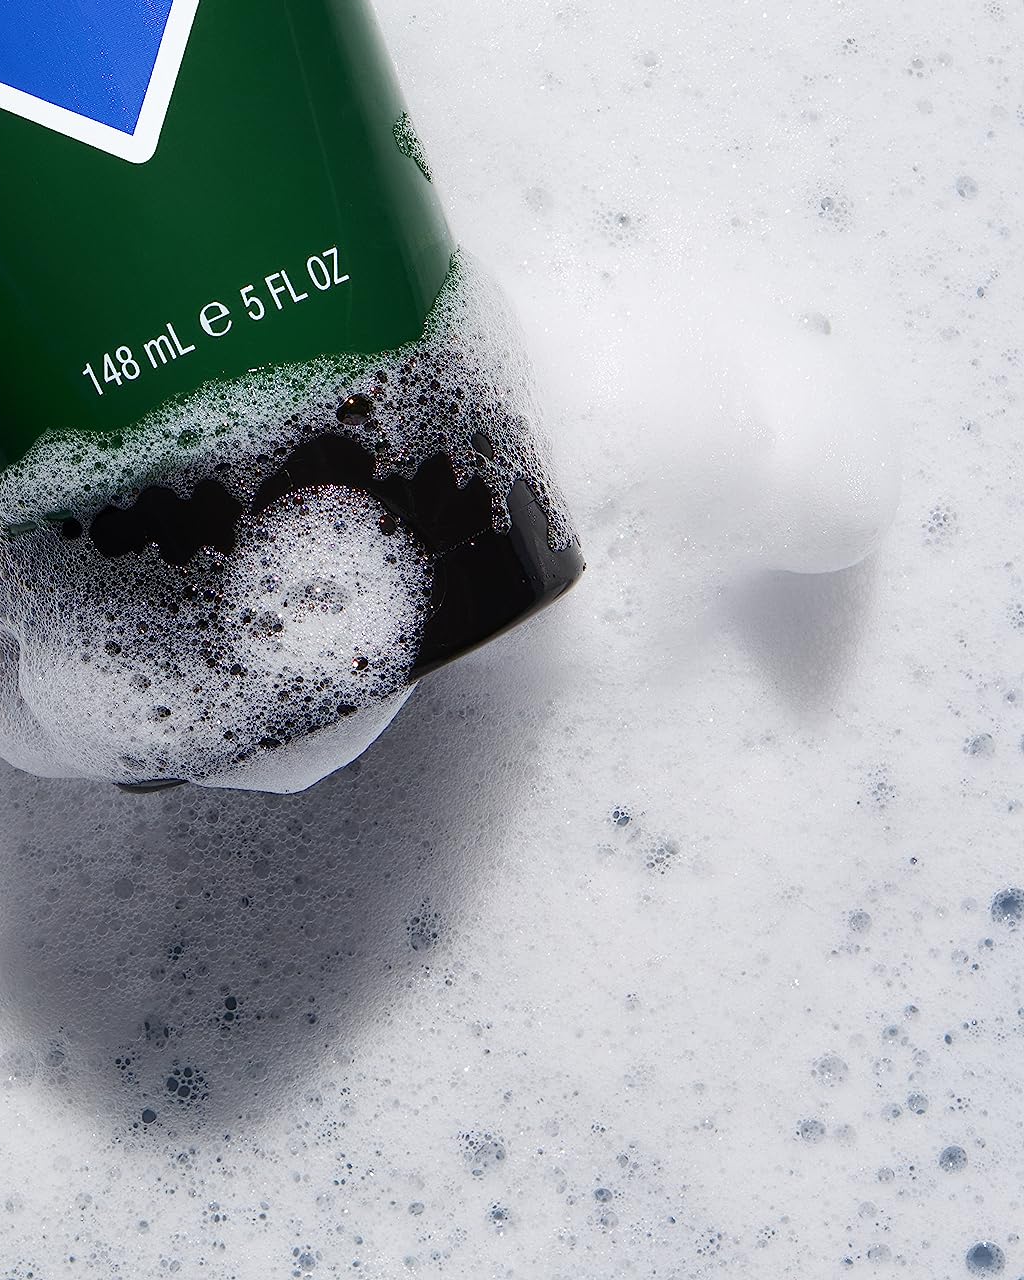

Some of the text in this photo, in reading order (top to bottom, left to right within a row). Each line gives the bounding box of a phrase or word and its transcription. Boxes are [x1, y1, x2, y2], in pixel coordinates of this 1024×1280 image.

[83, 346, 140, 395] 148
[144, 323, 195, 368] mL
[240, 285, 264, 320] 5
[265, 270, 308, 309] FL
[307, 247, 349, 290] OZ
